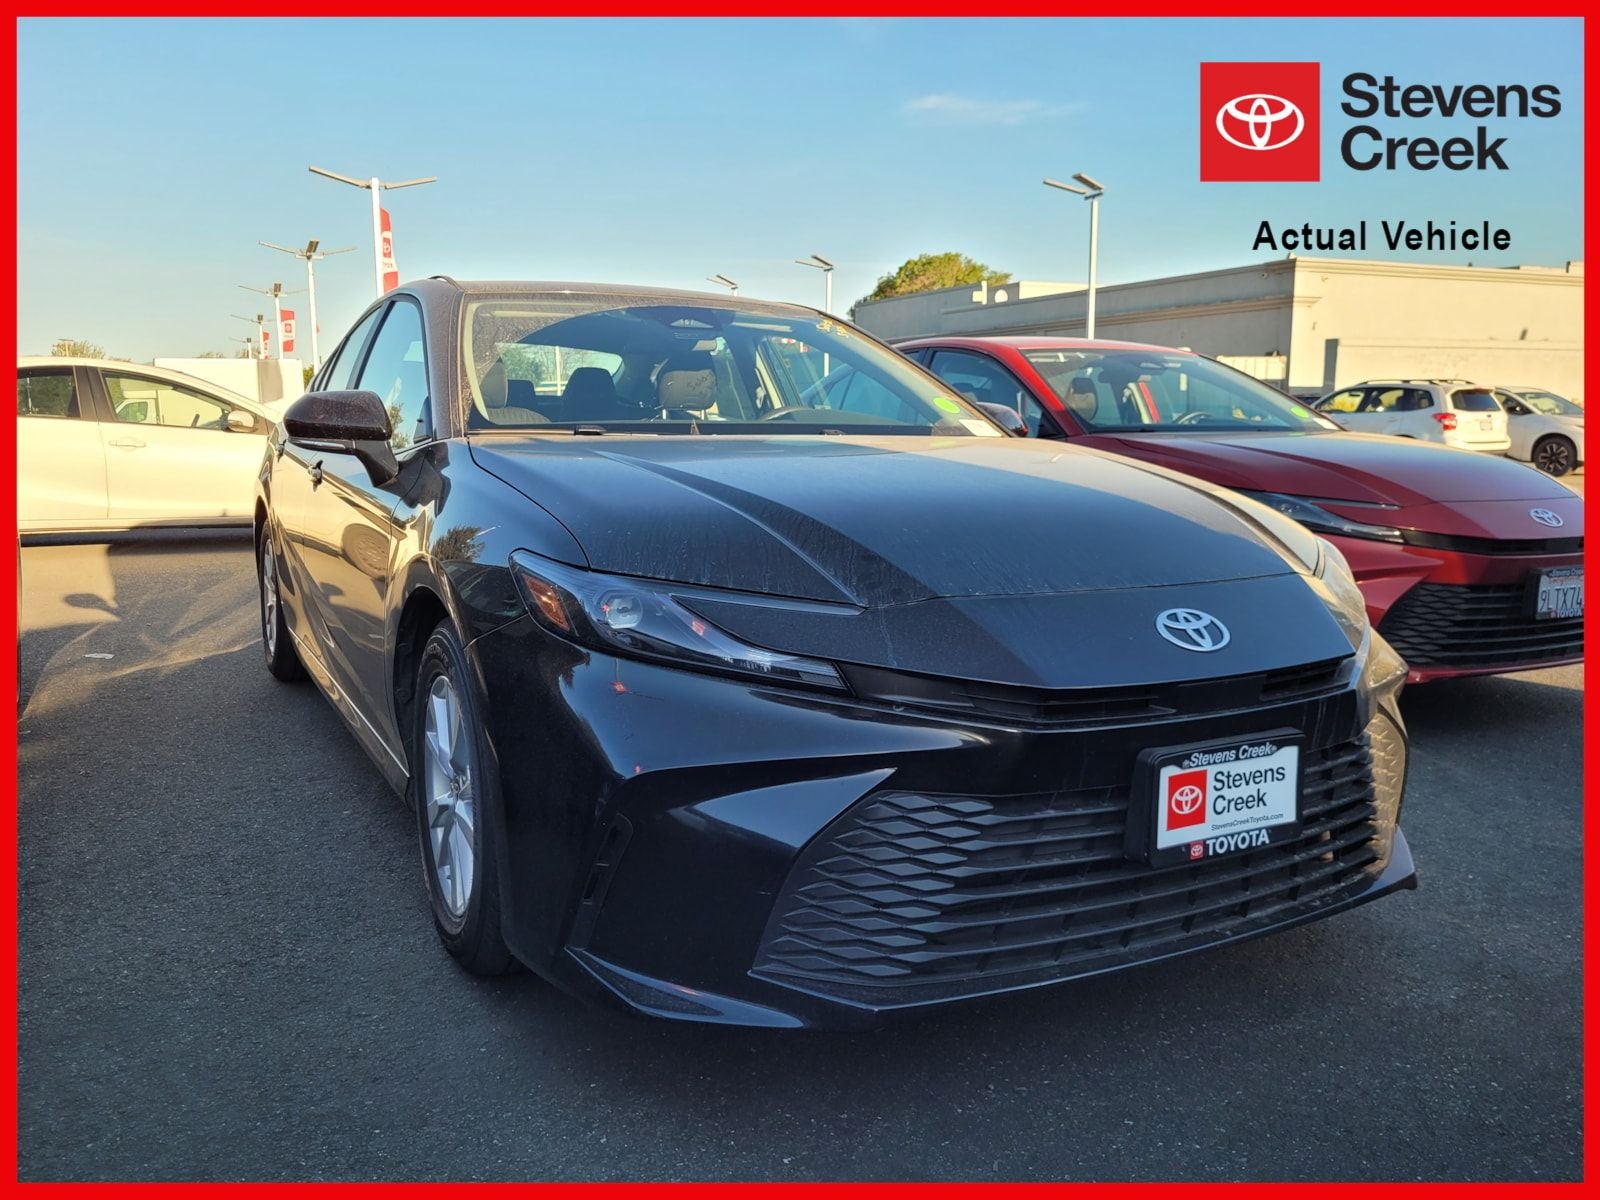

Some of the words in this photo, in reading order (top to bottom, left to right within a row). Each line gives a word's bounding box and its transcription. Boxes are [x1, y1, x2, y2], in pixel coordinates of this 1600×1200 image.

[1189, 750, 1236, 768] Stevens
[1238, 742, 1272, 760] Creek
[1213, 766, 1286, 791] Stevens
[1212, 788, 1268, 815] Creek
[1211, 812, 1284, 831] StevensCreekToyota.com
[1206, 829, 1270, 856] TOYOTA
